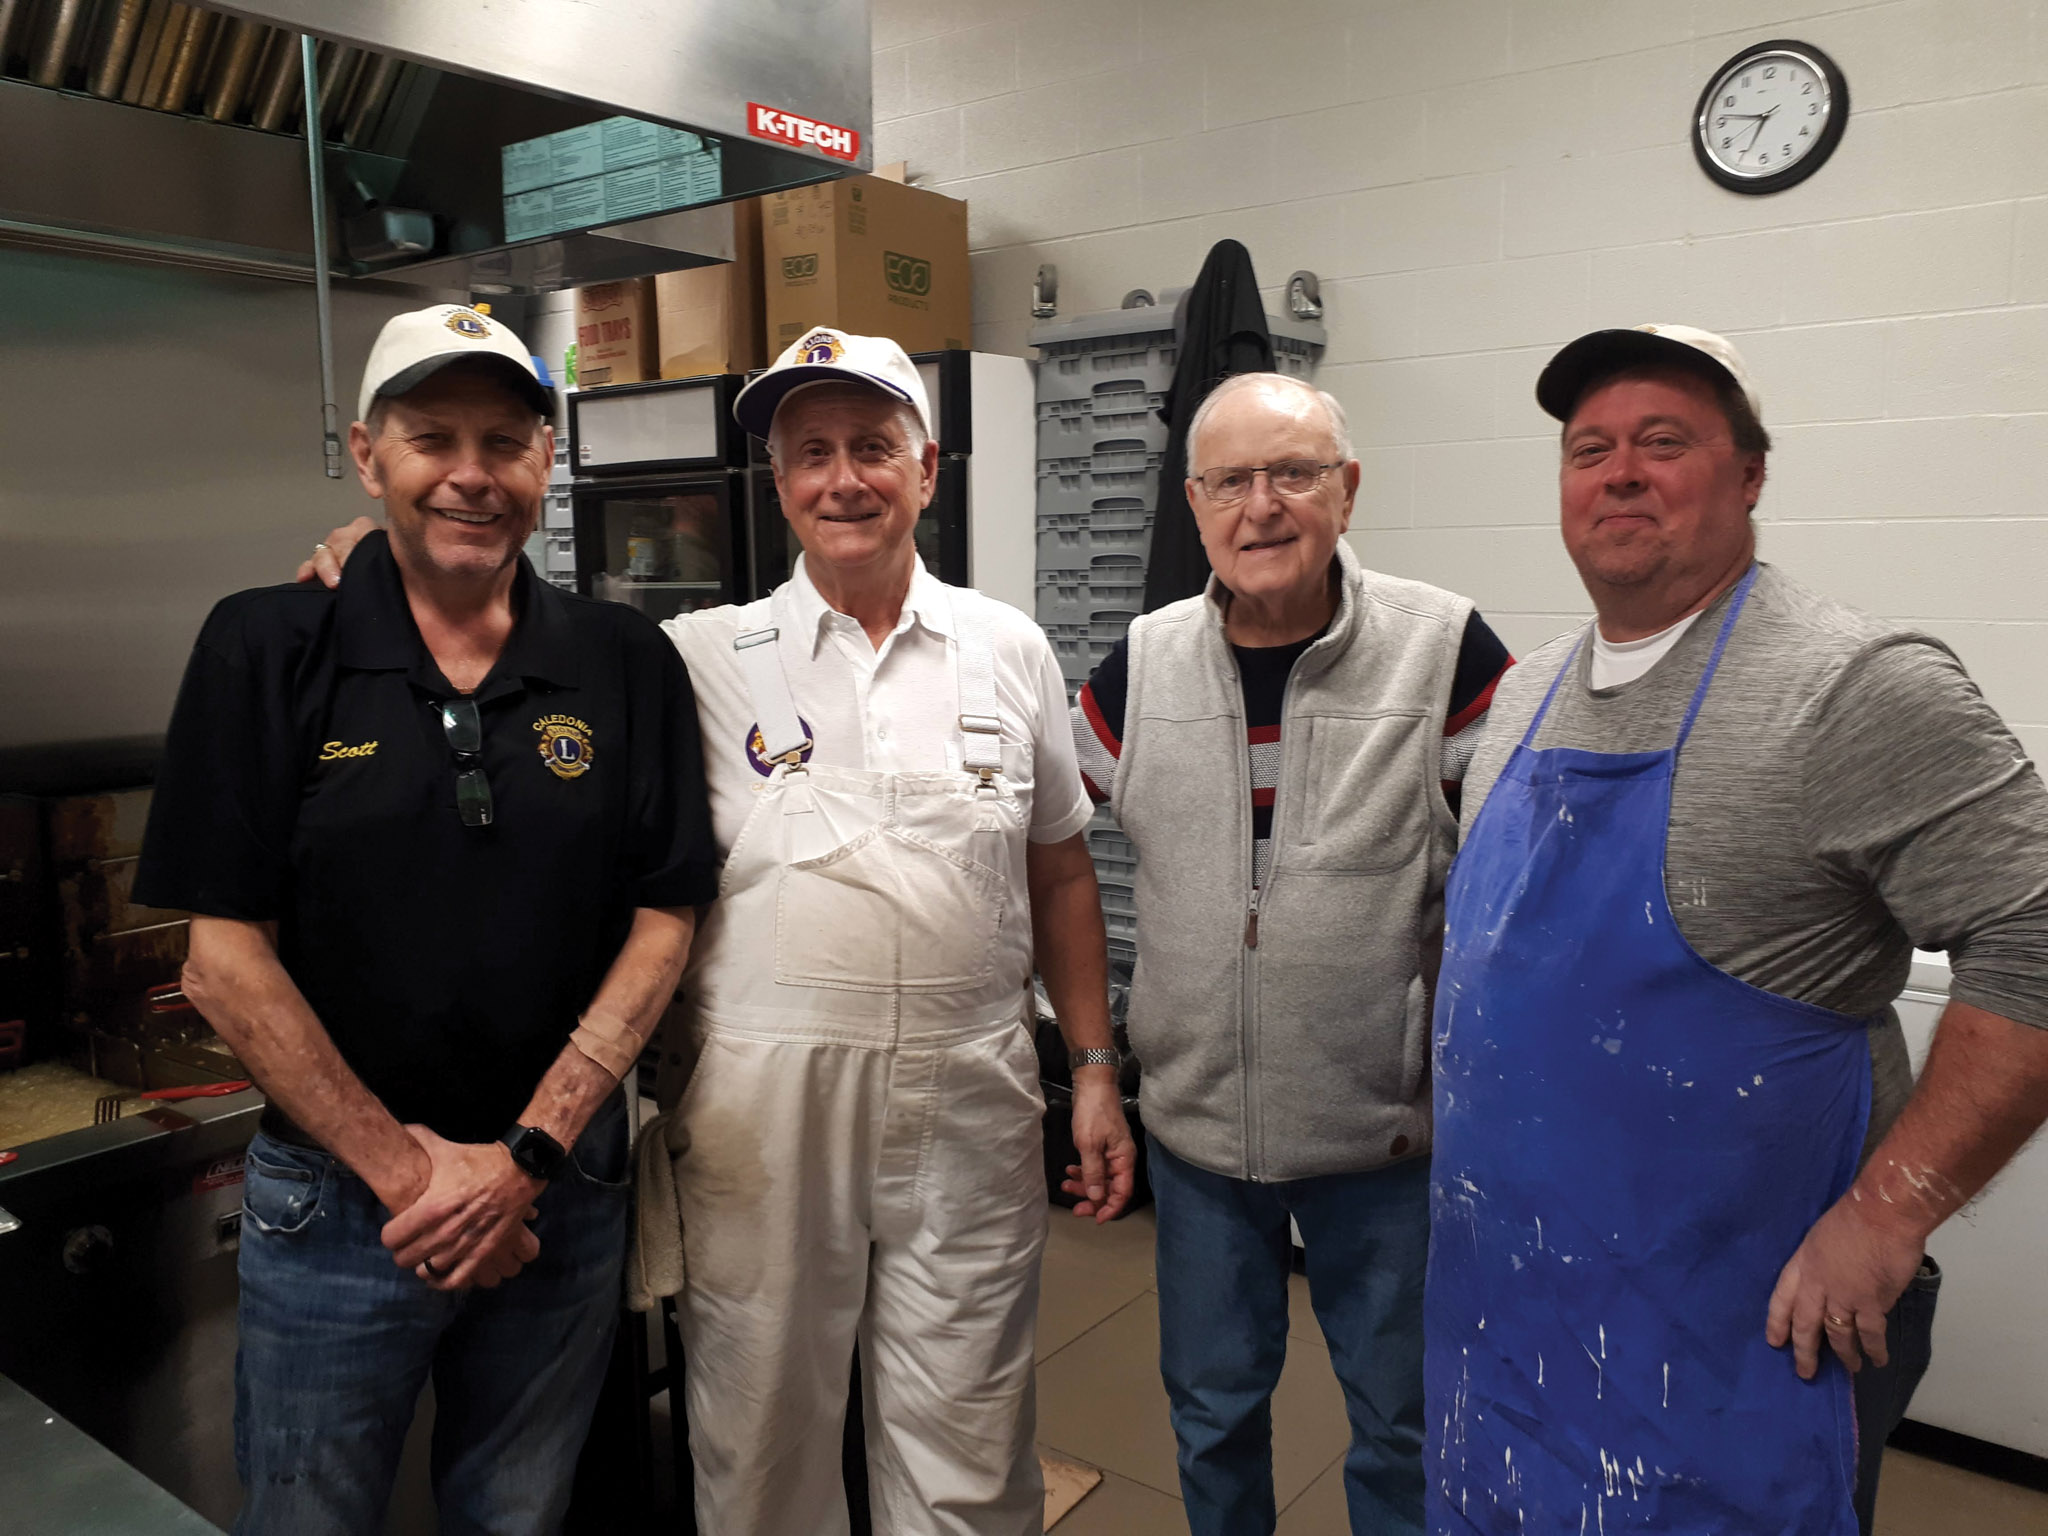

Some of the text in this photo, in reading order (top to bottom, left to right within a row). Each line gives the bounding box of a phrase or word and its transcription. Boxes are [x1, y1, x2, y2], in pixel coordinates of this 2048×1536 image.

[1762, 66, 1777, 80] 12
[1801, 82, 1812, 96] 2
[1723, 95, 1736, 108] 10
[1808, 103, 1818, 117] 3
[1716, 116, 1727, 129] 9
[756, 107, 852, 153] K-TECH
[1798, 125, 1809, 137] 4
[1721, 137, 1732, 149] 8
[1782, 144, 1792, 156] 5
[1737, 149, 1748, 164] 7
[1758, 152, 1770, 165] 6
[462, 320, 478, 332] L
[804, 333, 834, 350] LIONS
[812, 350, 827, 363] L
[532, 714, 593, 736] CALEDONIA
[319, 741, 379, 760] Scott
[559, 738, 576, 760] L
